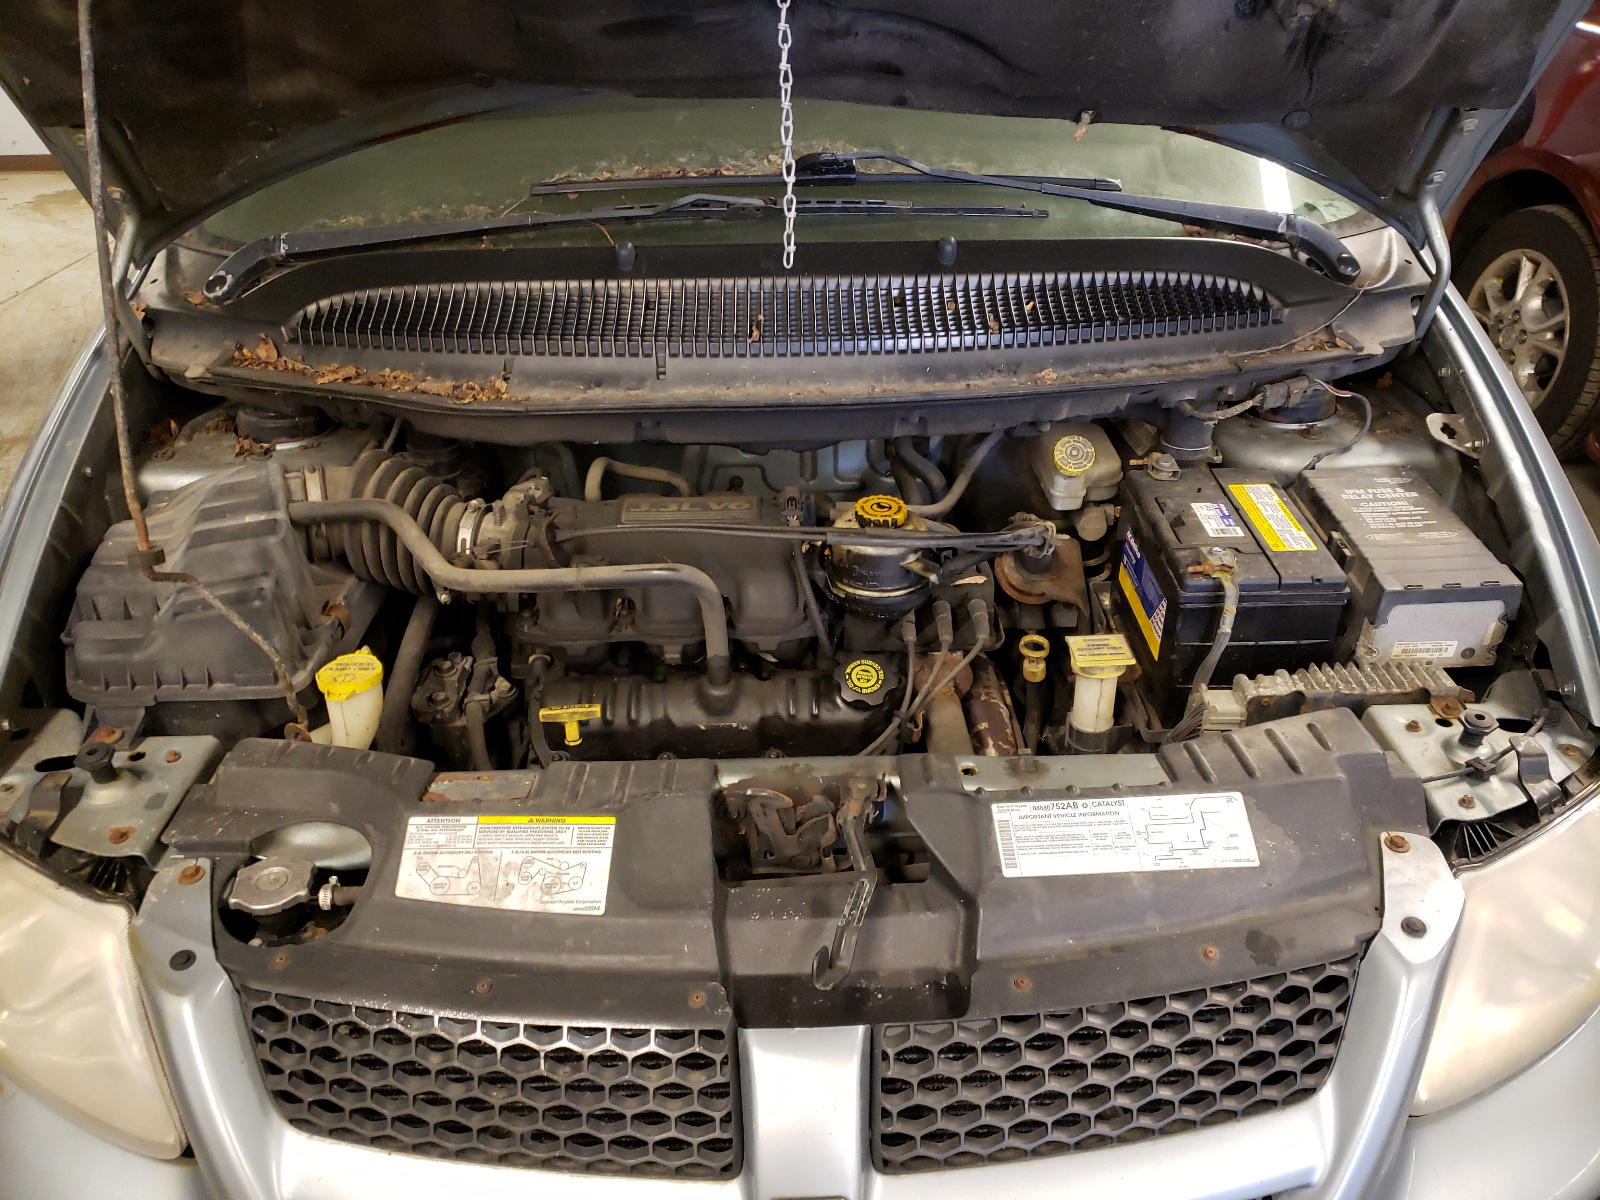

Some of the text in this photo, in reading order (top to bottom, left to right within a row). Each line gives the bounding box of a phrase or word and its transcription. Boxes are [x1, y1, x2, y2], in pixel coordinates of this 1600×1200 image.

[1377, 491, 1420, 499] CENTER
[1091, 799, 1125, 808] CATALYST
[1078, 810, 1120, 818] INFORMATION
